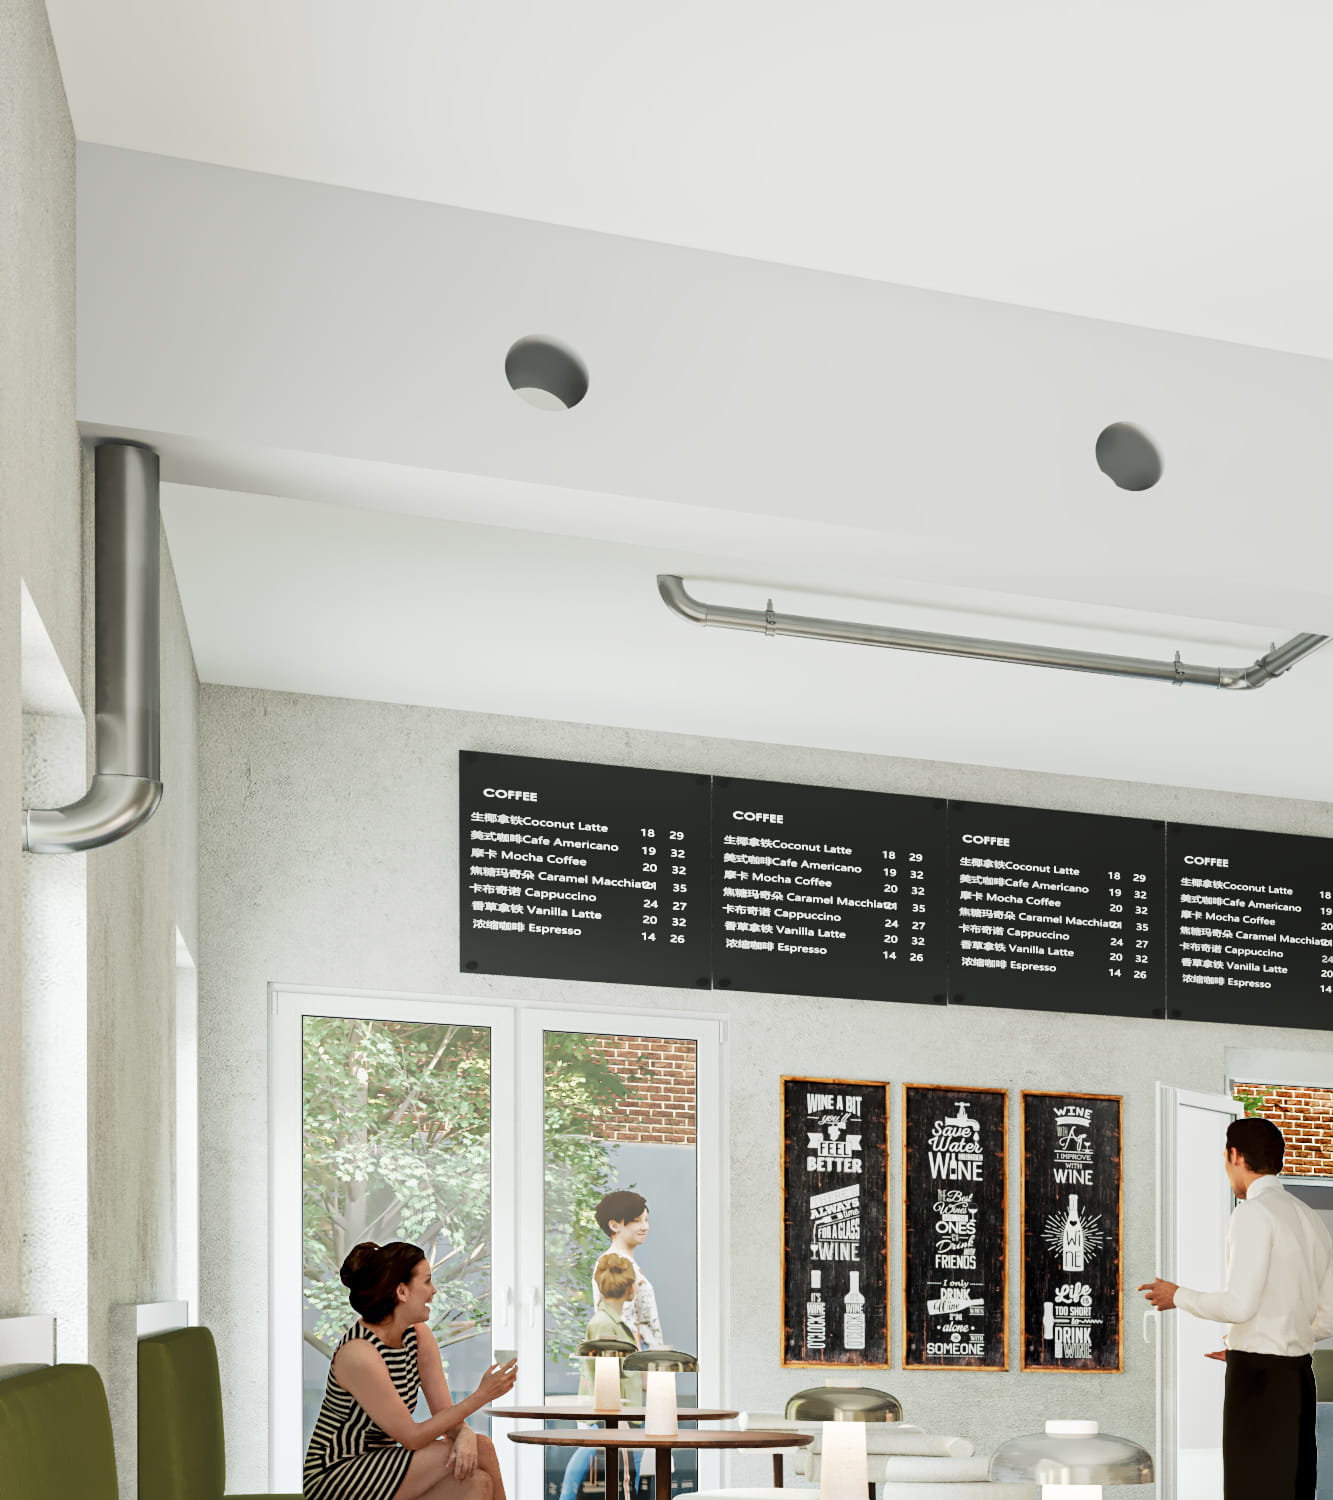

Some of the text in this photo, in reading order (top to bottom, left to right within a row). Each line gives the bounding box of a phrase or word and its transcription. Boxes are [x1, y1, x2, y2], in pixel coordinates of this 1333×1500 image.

[483, 788, 537, 802] COFFEE
[733, 811, 783, 824] COFFEE
[579, 822, 608, 832] Latte
[641, 829, 655, 837] 18
[670, 831, 684, 840] 29
[553, 838, 619, 851] Americano
[642, 847, 656, 855] 19
[671, 849, 685, 858] 32
[962, 835, 1009, 847] COFFEE
[824, 845, 922, 862] Latte 18 29
[502, 851, 543, 862] Mocha
[547, 855, 587, 866] Coffee
[643, 863, 657, 872] 20
[672, 866, 686, 875] 32
[801, 860, 862, 873] Americano
[1184, 856, 1228, 867] COFFEE
[752, 873, 832, 887] Mocha Coffee
[1054, 866, 1146, 882] Latte 18 29
[538, 872, 588, 884] Caramel
[673, 884, 687, 892] 35
[1032, 881, 1089, 893] Americano
[525, 888, 596, 901] Cappuccino
[644, 899, 658, 908] 24
[673, 902, 687, 910] 27
[787, 893, 833, 904] Caramel
[1269, 886, 1293, 895] Latte
[1320, 891, 1331, 899] 18
[987, 893, 1061, 907] Mocha Coffee
[1248, 900, 1301, 912] Americano
[527, 905, 568, 916] Vanilla
[572, 909, 602, 919] Latte
[643, 915, 657, 924] 20
[672, 918, 686, 926] 32
[774, 909, 841, 921] Cappuccino
[1019, 913, 1062, 923] Caramel
[1206, 912, 1275, 925] Mocha Coffee
[529, 923, 581, 935] Espresso
[642, 932, 656, 941] 14
[670, 935, 685, 943] 26
[776, 925, 846, 938] Vanilla Latte
[1007, 928, 1069, 940] Cappuccino
[1236, 931, 1276, 941] Caramel
[778, 943, 827, 954] Espresso
[1009, 944, 1074, 956] Vanilla Latte
[1225, 946, 1283, 957] Cappuccino
[1011, 961, 1056, 972] Espresso
[1227, 962, 1288, 973] Vanilla Latte
[1228, 978, 1271, 988] Espresso
[807, 1093, 863, 1117] WINE A BIT
[1053, 1105, 1094, 1120] WINE
[931, 1120, 972, 1138] Save
[820, 1142, 850, 1156] FEEL
[927, 1136, 983, 1154] Water
[806, 1156, 863, 1174] BETTER
[1053, 1168, 1094, 1186] WINE
[810, 1197, 860, 1220] ALWAYS
[935, 1220, 977, 1235] ONES
[818, 1241, 860, 1261] WINE
[935, 1234, 976, 1254] Drink
[935, 1254, 977, 1270] FRIENDS
[949, 1279, 970, 1289] only
[940, 1287, 971, 1301] DRINK
[1054, 1281, 1093, 1304] Life
[807, 1302, 826, 1315] WINE
[1054, 1305, 1093, 1317] TOO SHORT
[942, 1320, 970, 1333] alone
[1054, 1326, 1093, 1346] DRINK
[926, 1342, 985, 1355] SOMEONE
